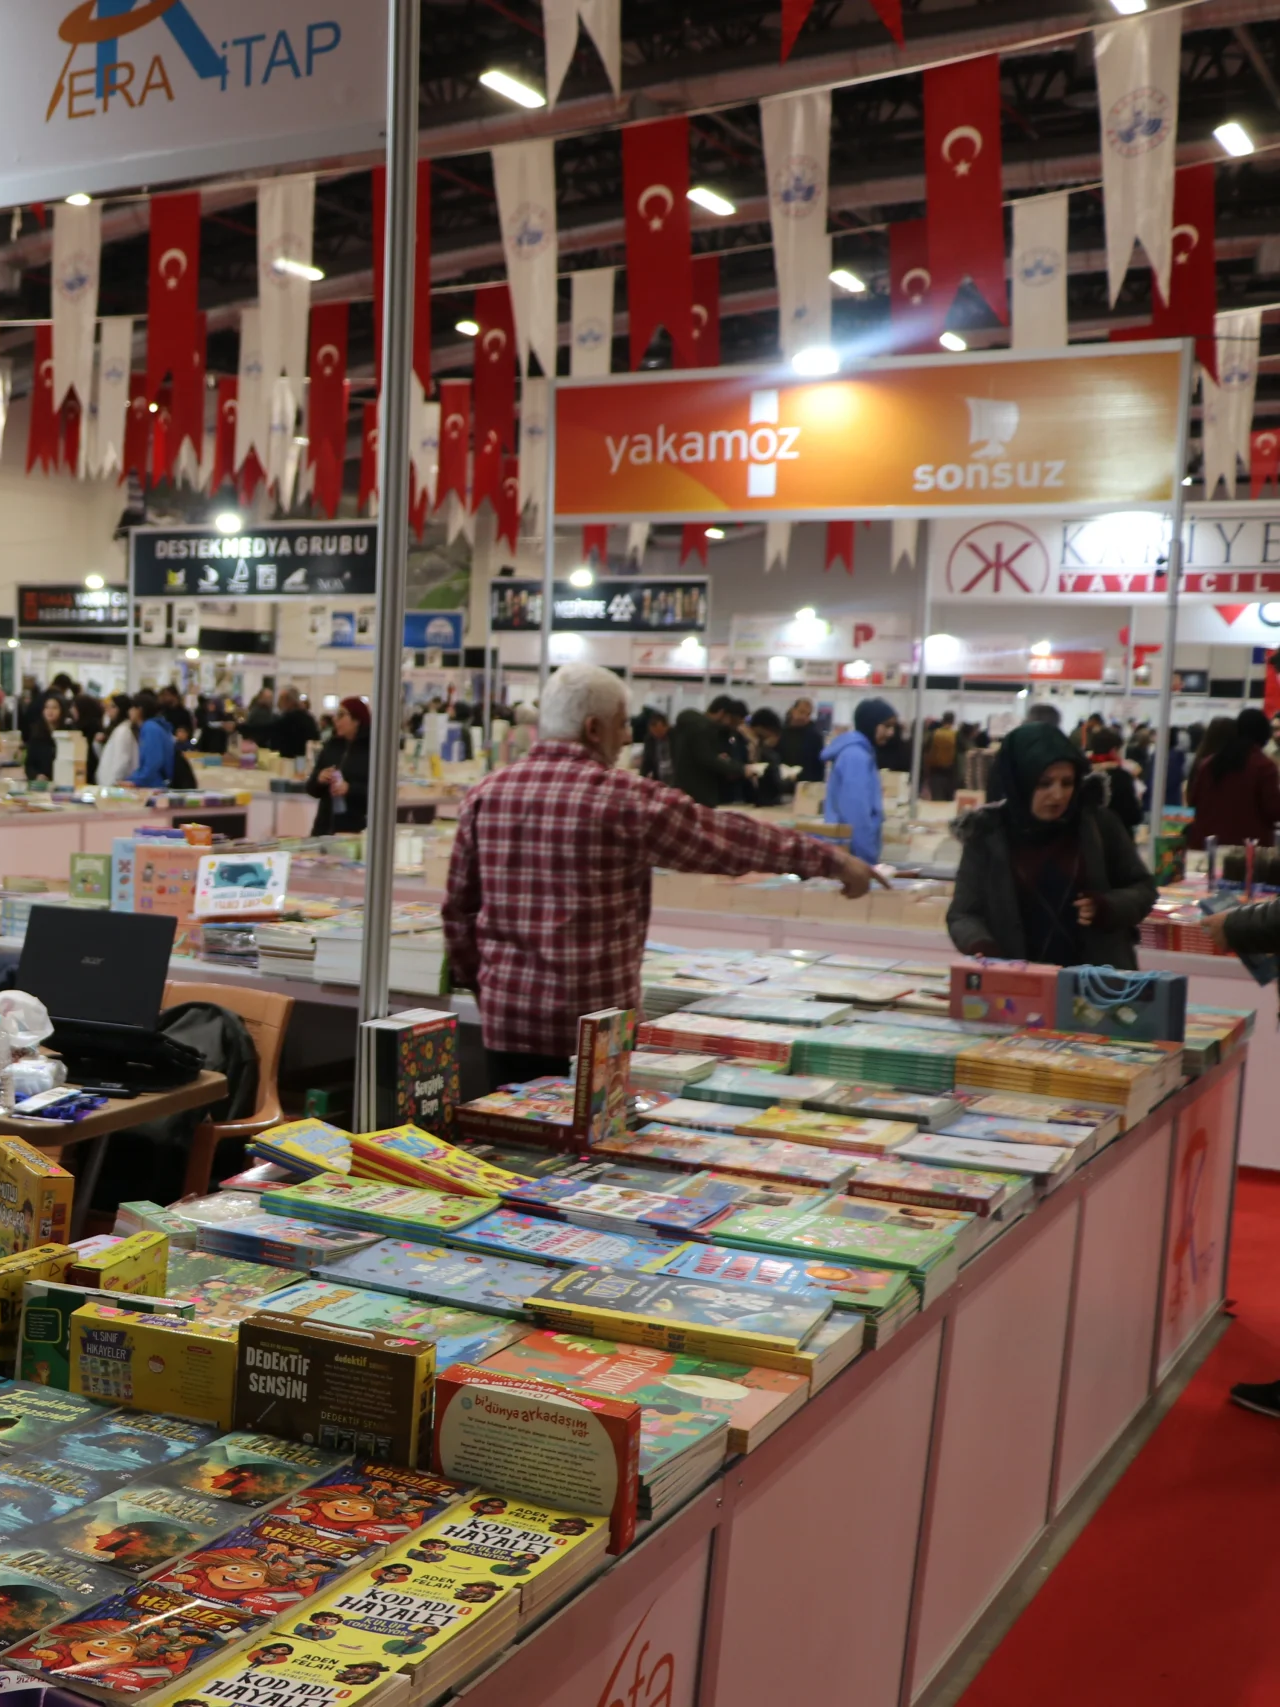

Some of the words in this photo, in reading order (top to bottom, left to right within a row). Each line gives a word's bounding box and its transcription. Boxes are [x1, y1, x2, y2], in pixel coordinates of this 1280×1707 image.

[605, 425, 801, 474] yakamoz
[912, 459, 1067, 492] sonsuz
[294, 534, 369, 556] GRUBU
[245, 1346, 311, 1377] DEDEKTİF
[248, 1372, 309, 1403] SENSİN!
[485, 1401, 521, 1418] dünya
[520, 1406, 588, 1430] arkadaşım
[561, 1428, 589, 1438] var
[508, 1511, 547, 1524] FELAH
[514, 1507, 550, 1519] ADEN
[440, 1524, 557, 1556] HAYALET
[466, 1519, 513, 1535] KOD
[516, 1530, 553, 1544] ADI
[411, 1578, 454, 1590] FELAH
[420, 1573, 457, 1584] ADEN
[335, 1595, 458, 1627] HAYALET
[365, 1588, 402, 1606] KOD
[418, 1601, 457, 1615] ADI
[290, 1657, 336, 1672] FELAH
[301, 1653, 341, 1665] ADEN
[236, 1671, 285, 1691] KOD
[294, 1683, 336, 1698] ADI
